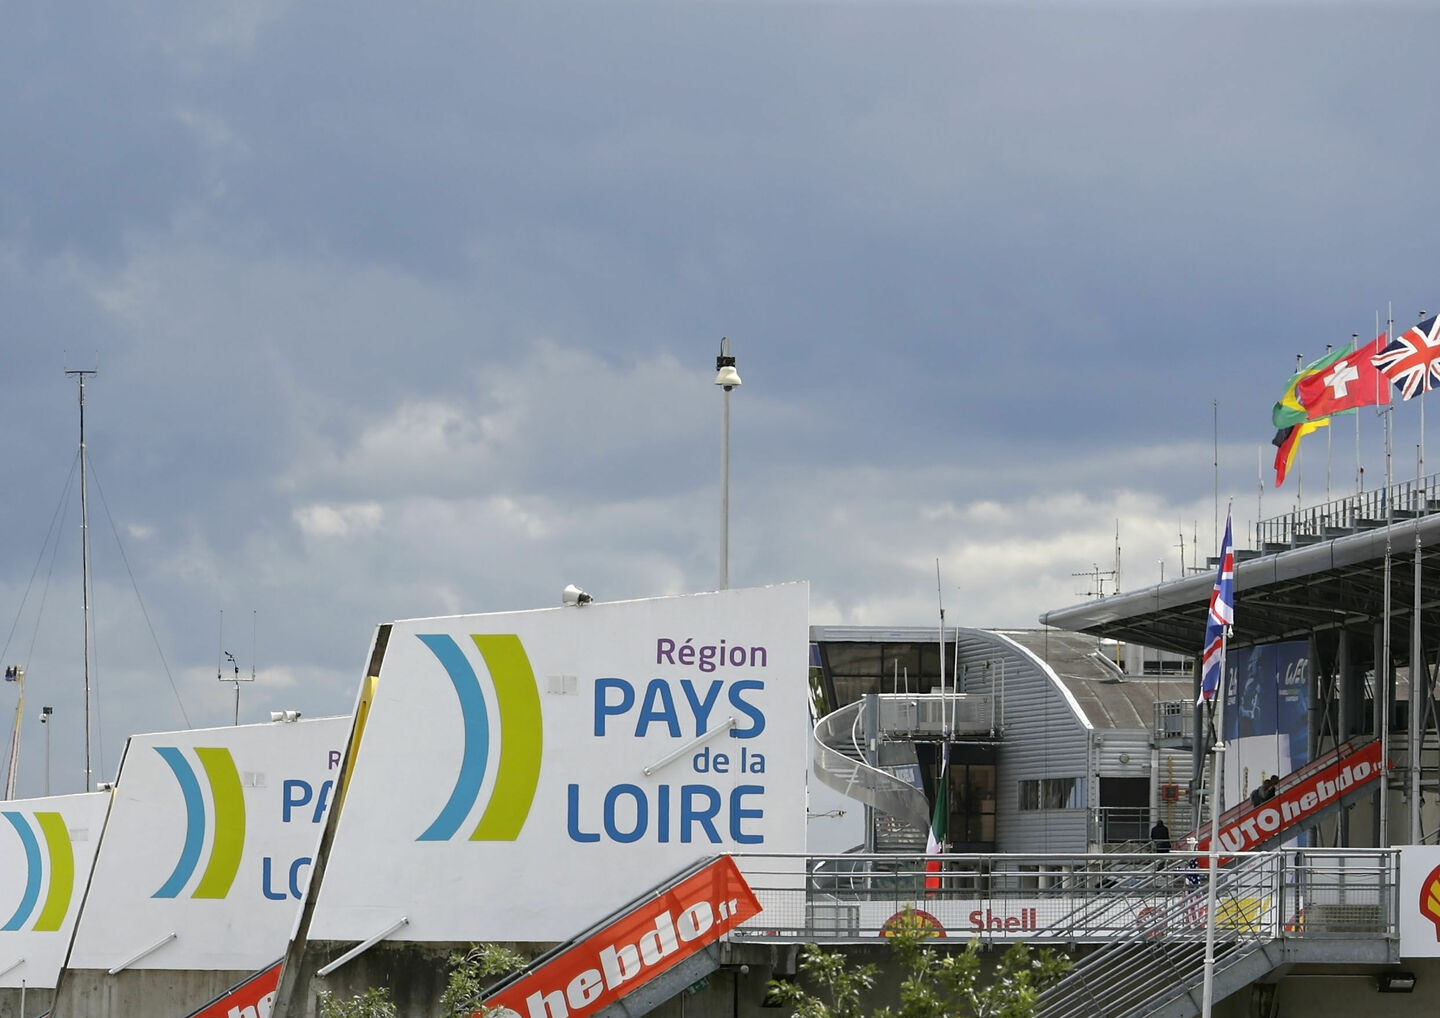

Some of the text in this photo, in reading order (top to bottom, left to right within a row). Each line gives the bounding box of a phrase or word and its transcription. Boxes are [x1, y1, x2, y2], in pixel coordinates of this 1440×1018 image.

[656, 638, 767, 673] Région
[594, 678, 766, 739] PAYS
[693, 746, 765, 774] de la
[282, 779, 333, 823] PA
[567, 784, 765, 844] LOIRE
[968, 907, 1037, 934] Shell
